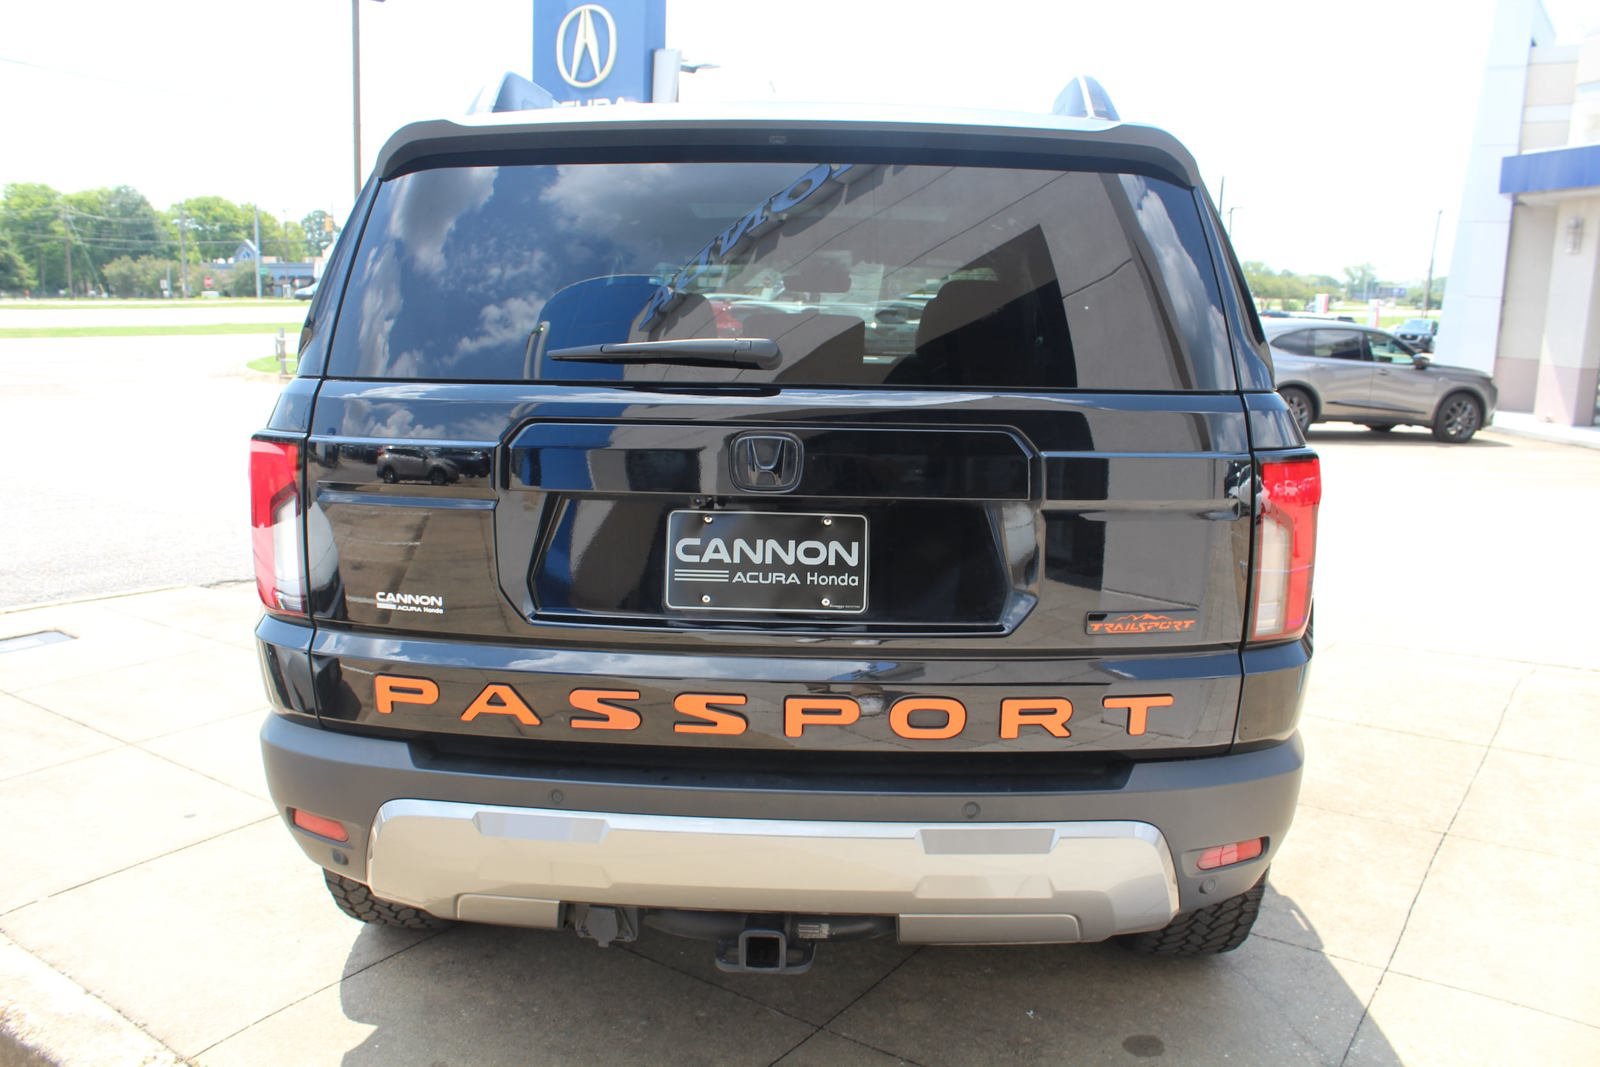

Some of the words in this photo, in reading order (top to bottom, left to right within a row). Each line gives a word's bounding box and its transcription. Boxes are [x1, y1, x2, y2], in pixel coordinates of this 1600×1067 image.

[675, 537, 859, 567] CANNON
[732, 571, 801, 585] ACURA
[806, 572, 859, 586] Honda
[375, 591, 443, 607] CANNON
[397, 605, 422, 613] ACURA
[1090, 619, 1196, 634] TRAILSPORT
[374, 673, 1174, 740] PASSPORT
